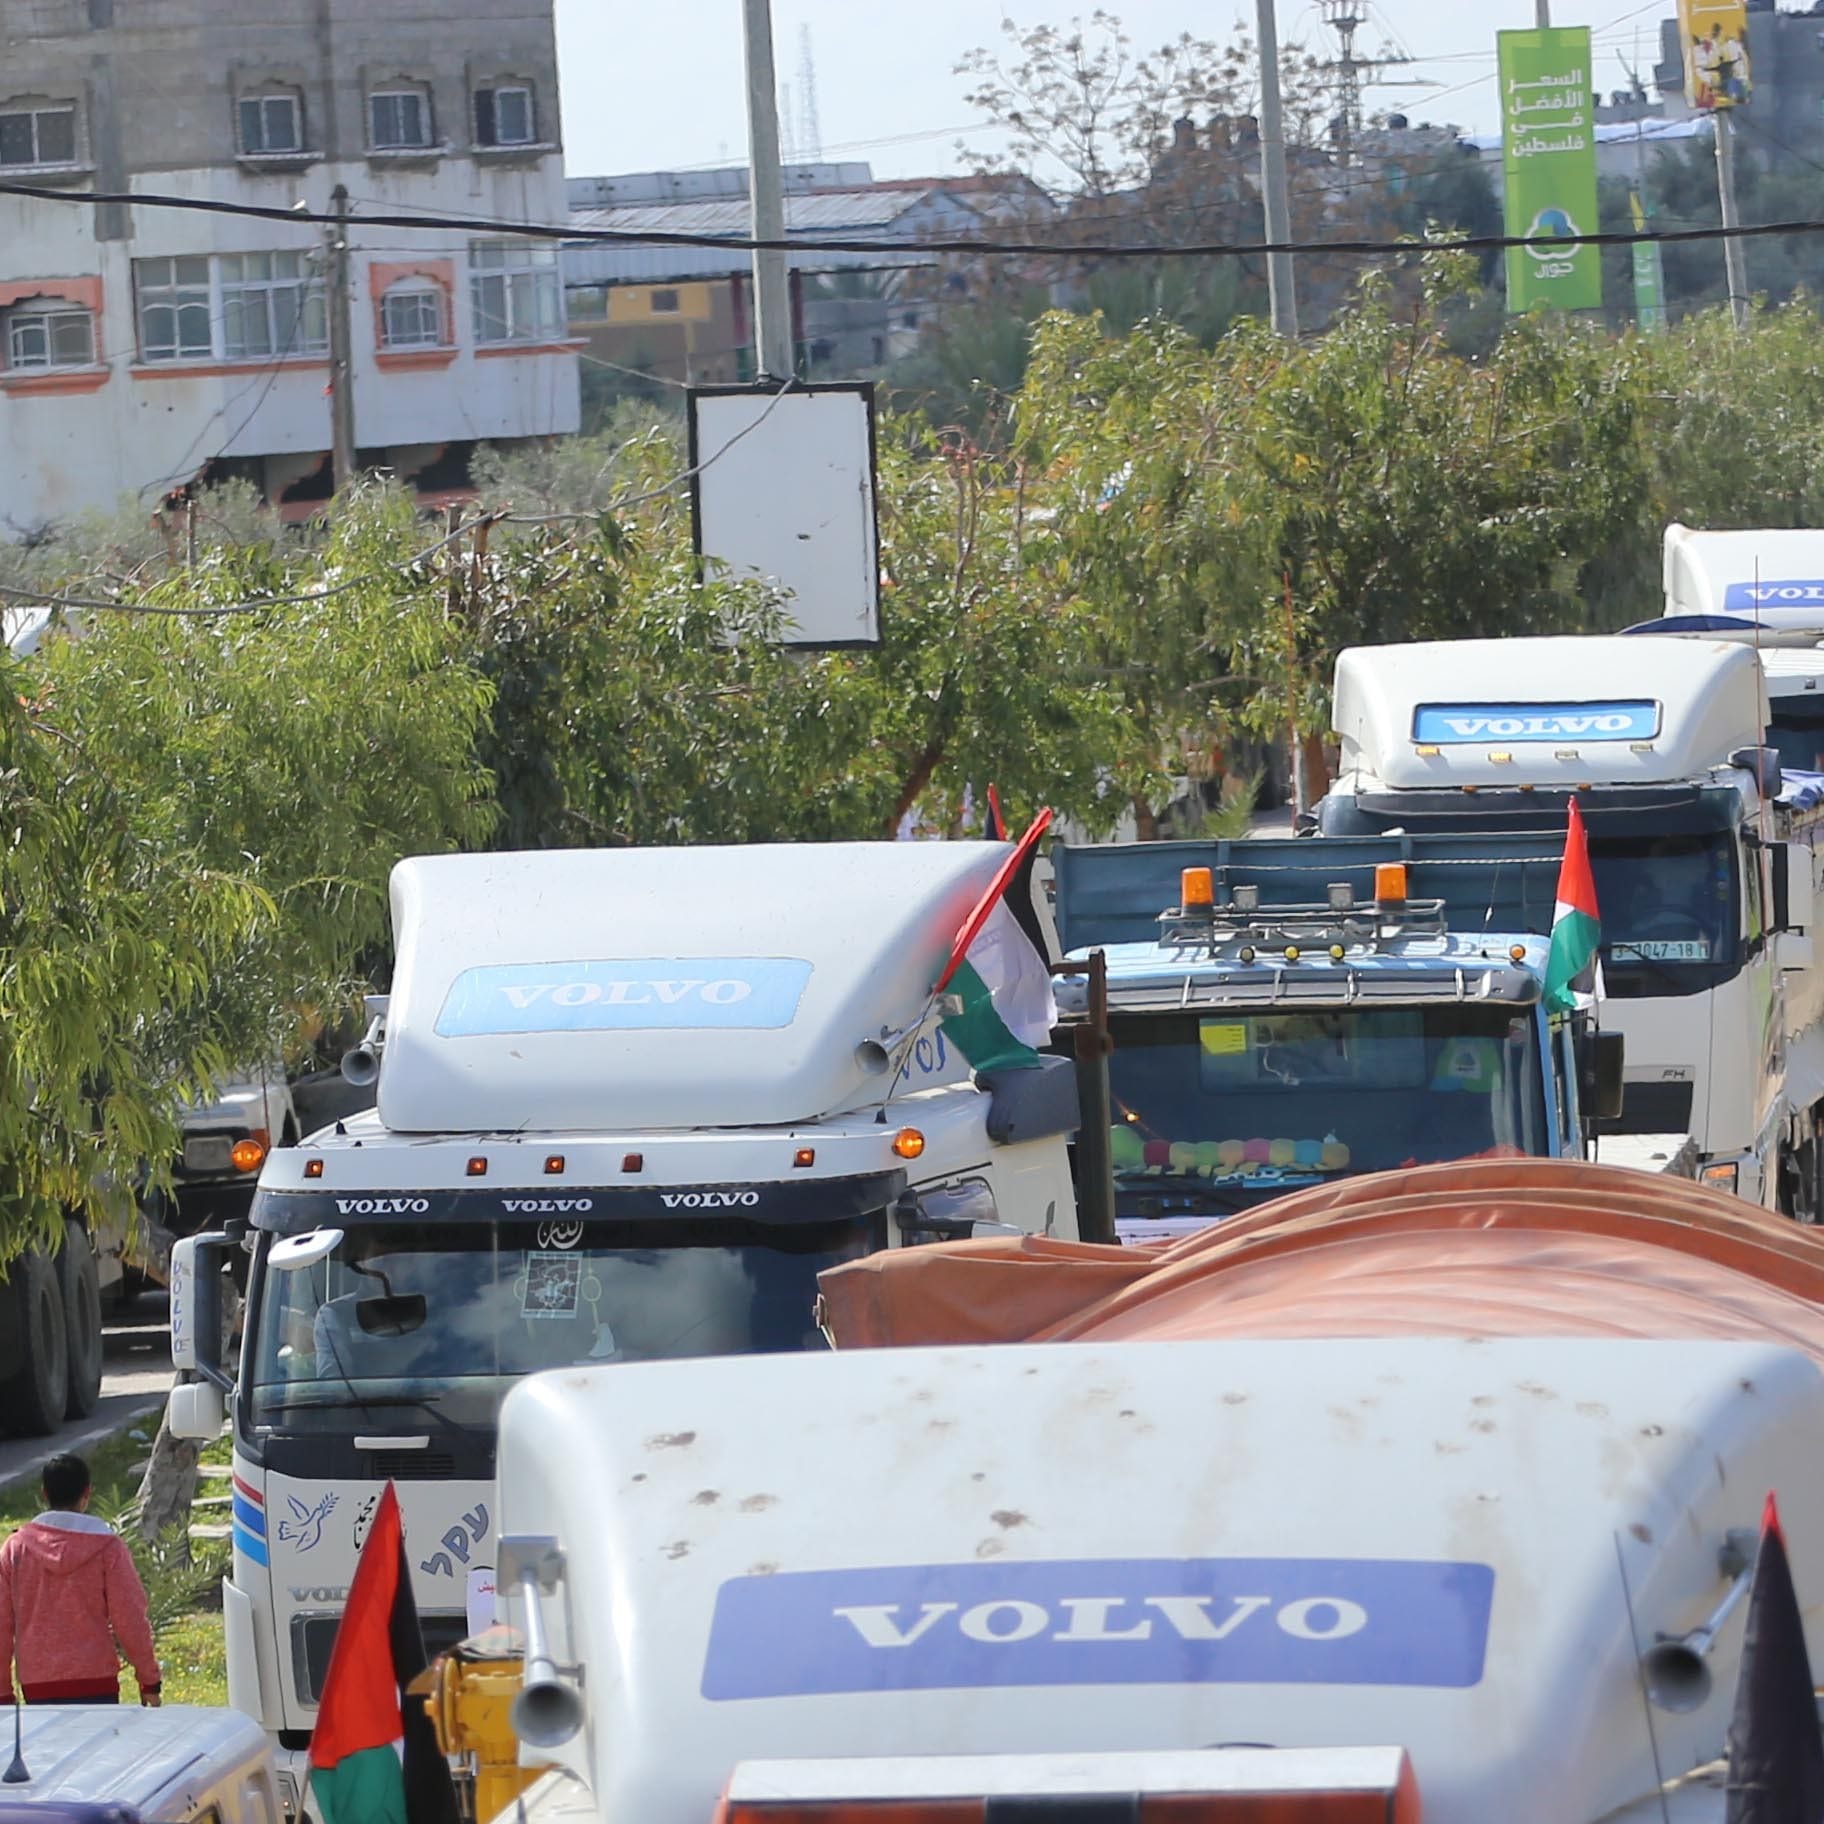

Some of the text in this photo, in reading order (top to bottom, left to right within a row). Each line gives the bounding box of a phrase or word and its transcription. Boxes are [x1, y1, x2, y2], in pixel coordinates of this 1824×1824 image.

[1509, 69, 1583, 93] السعر
[1509, 91, 1585, 116] الأفضل
[1511, 112, 1585, 133] في
[1512, 135, 1585, 157] فلسطين
[1443, 714, 1633, 736] VOLVO
[498, 979, 752, 1010] VOLVO
[335, 1190, 760, 1214] VOLVO VOLVO VOLVO
[420, 1503, 490, 1577] עקל
[832, 1597, 1368, 1648] VOLVO
